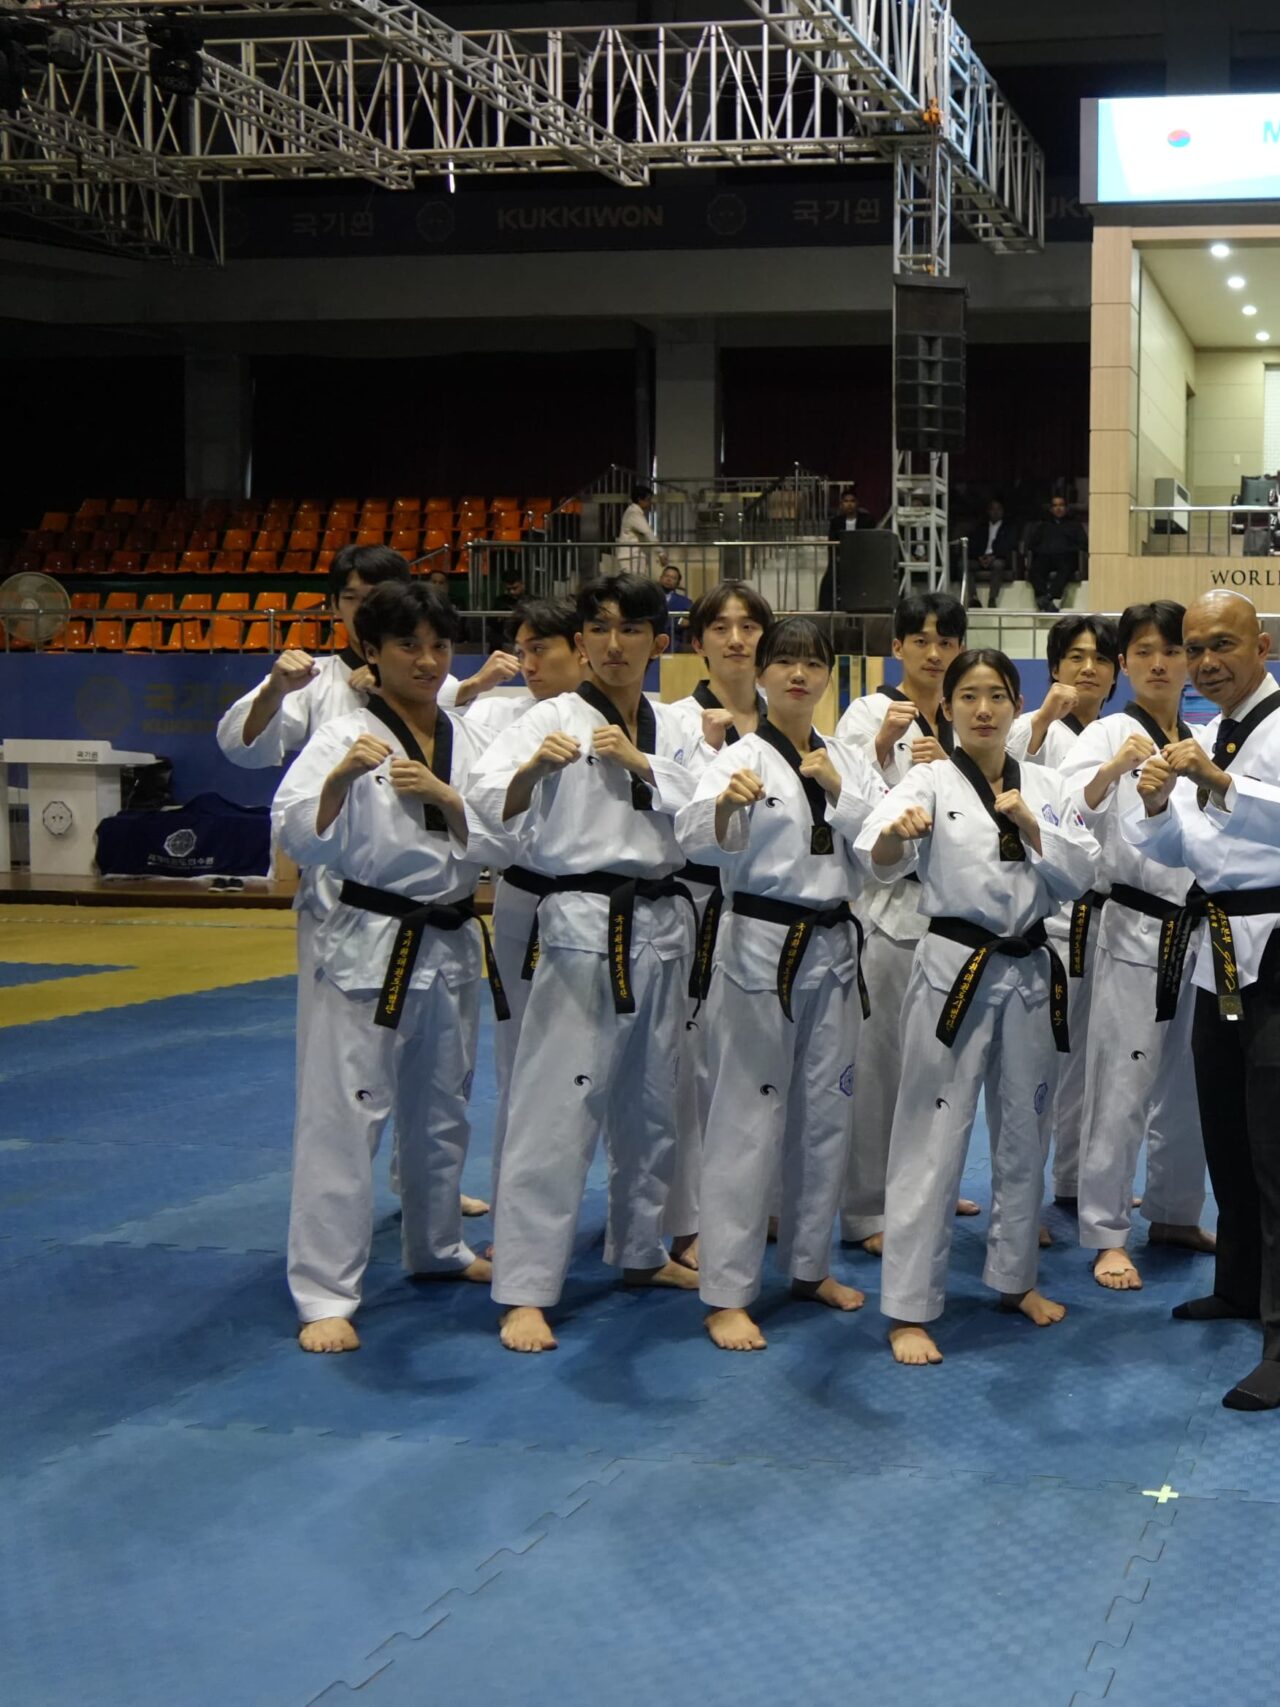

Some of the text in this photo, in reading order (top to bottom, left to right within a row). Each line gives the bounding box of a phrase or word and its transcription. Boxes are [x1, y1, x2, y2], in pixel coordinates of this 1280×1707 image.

[292, 210, 375, 238] 국기원
[497, 204, 663, 231] KUKKIWON
[792, 197, 881, 226] 국기원
